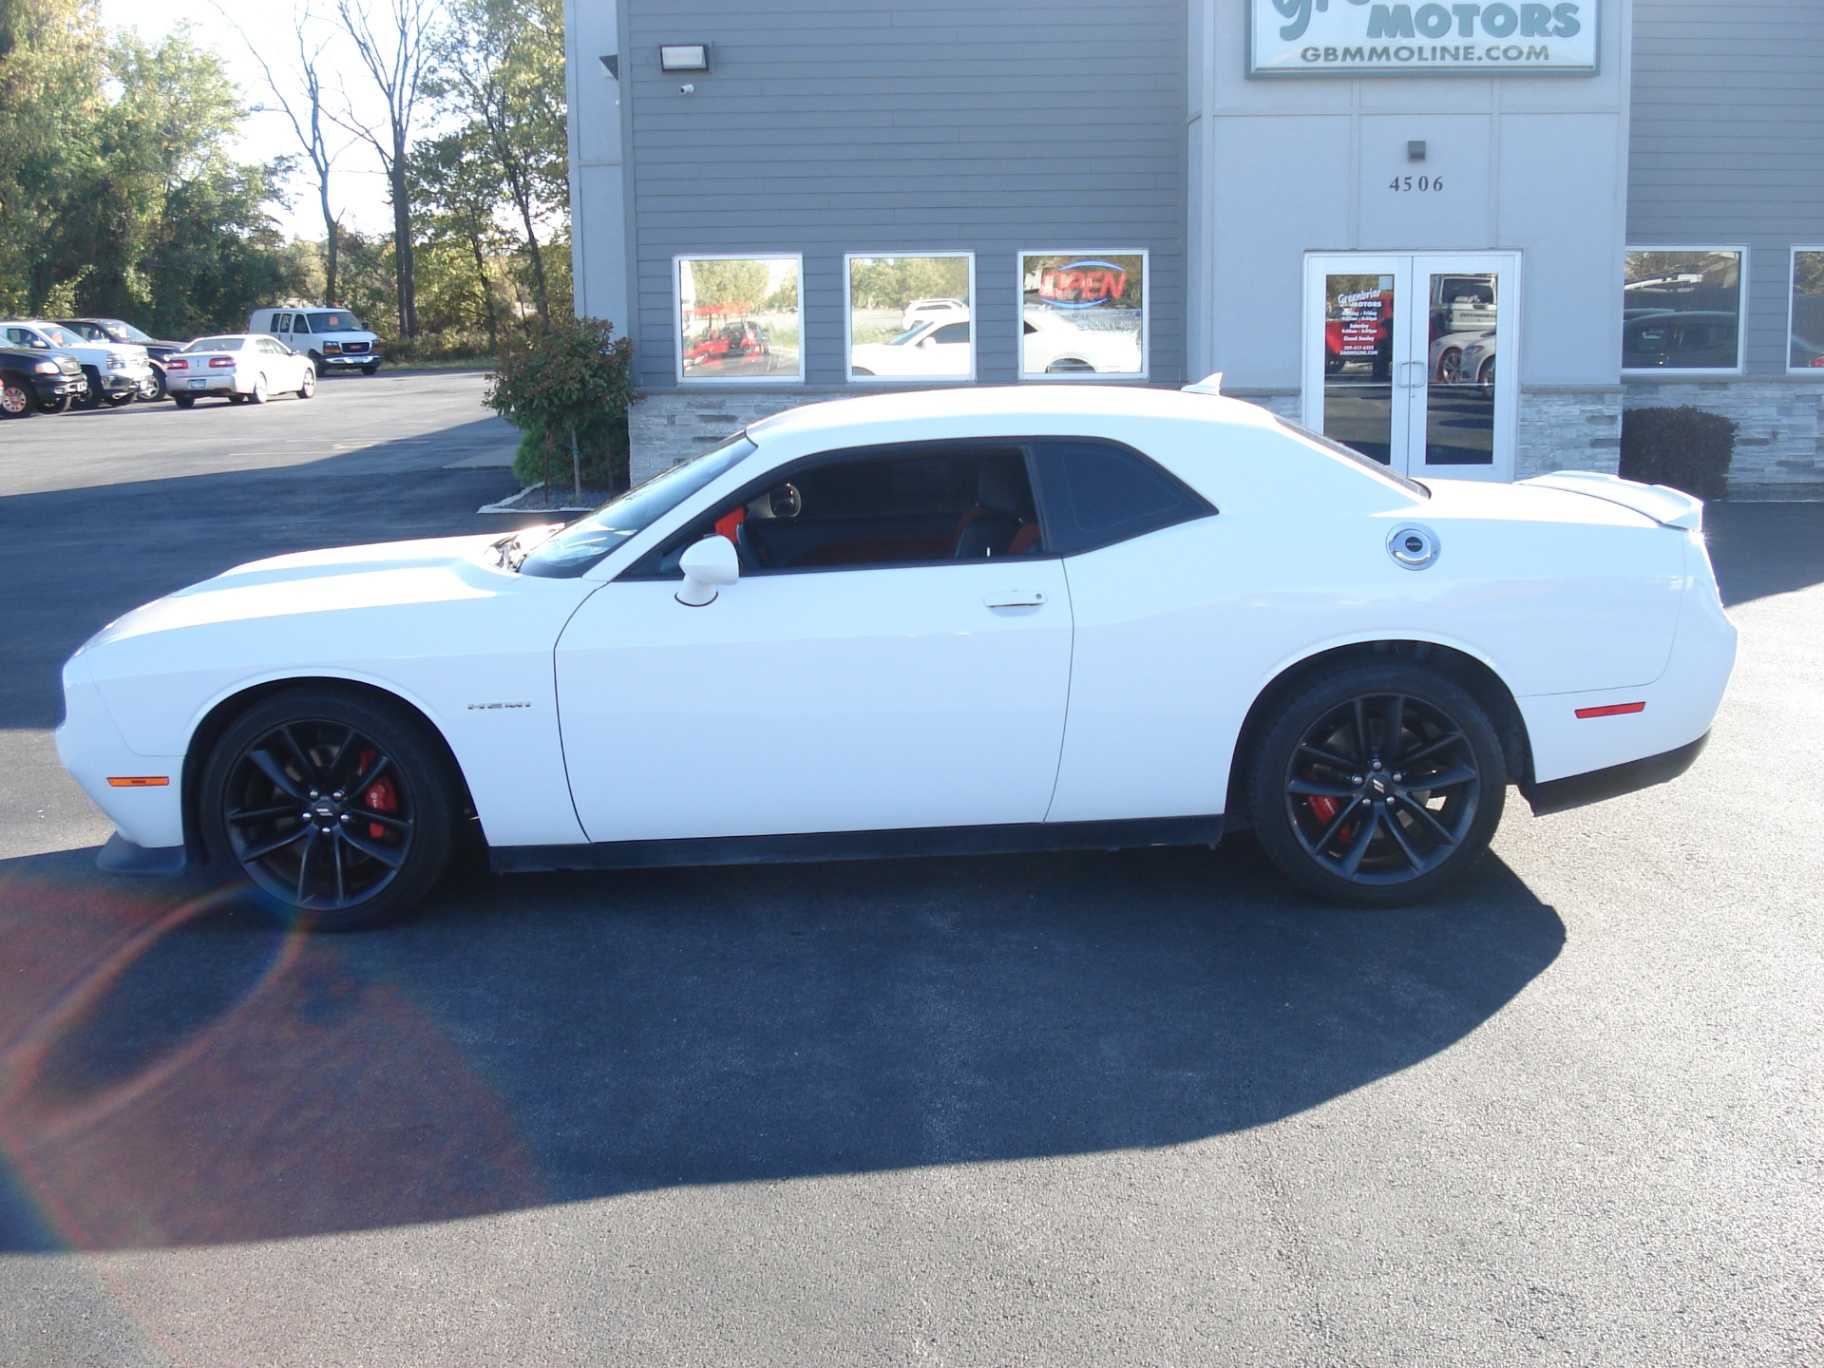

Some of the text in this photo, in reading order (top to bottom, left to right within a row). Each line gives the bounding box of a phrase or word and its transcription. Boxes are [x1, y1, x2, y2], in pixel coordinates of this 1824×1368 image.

[1366, 3, 1581, 39] MOTORS
[1301, 45, 1550, 63] GBMMOLINE.COM
[1389, 175, 1443, 192] 4506
[1040, 270, 1127, 301] OPEN
